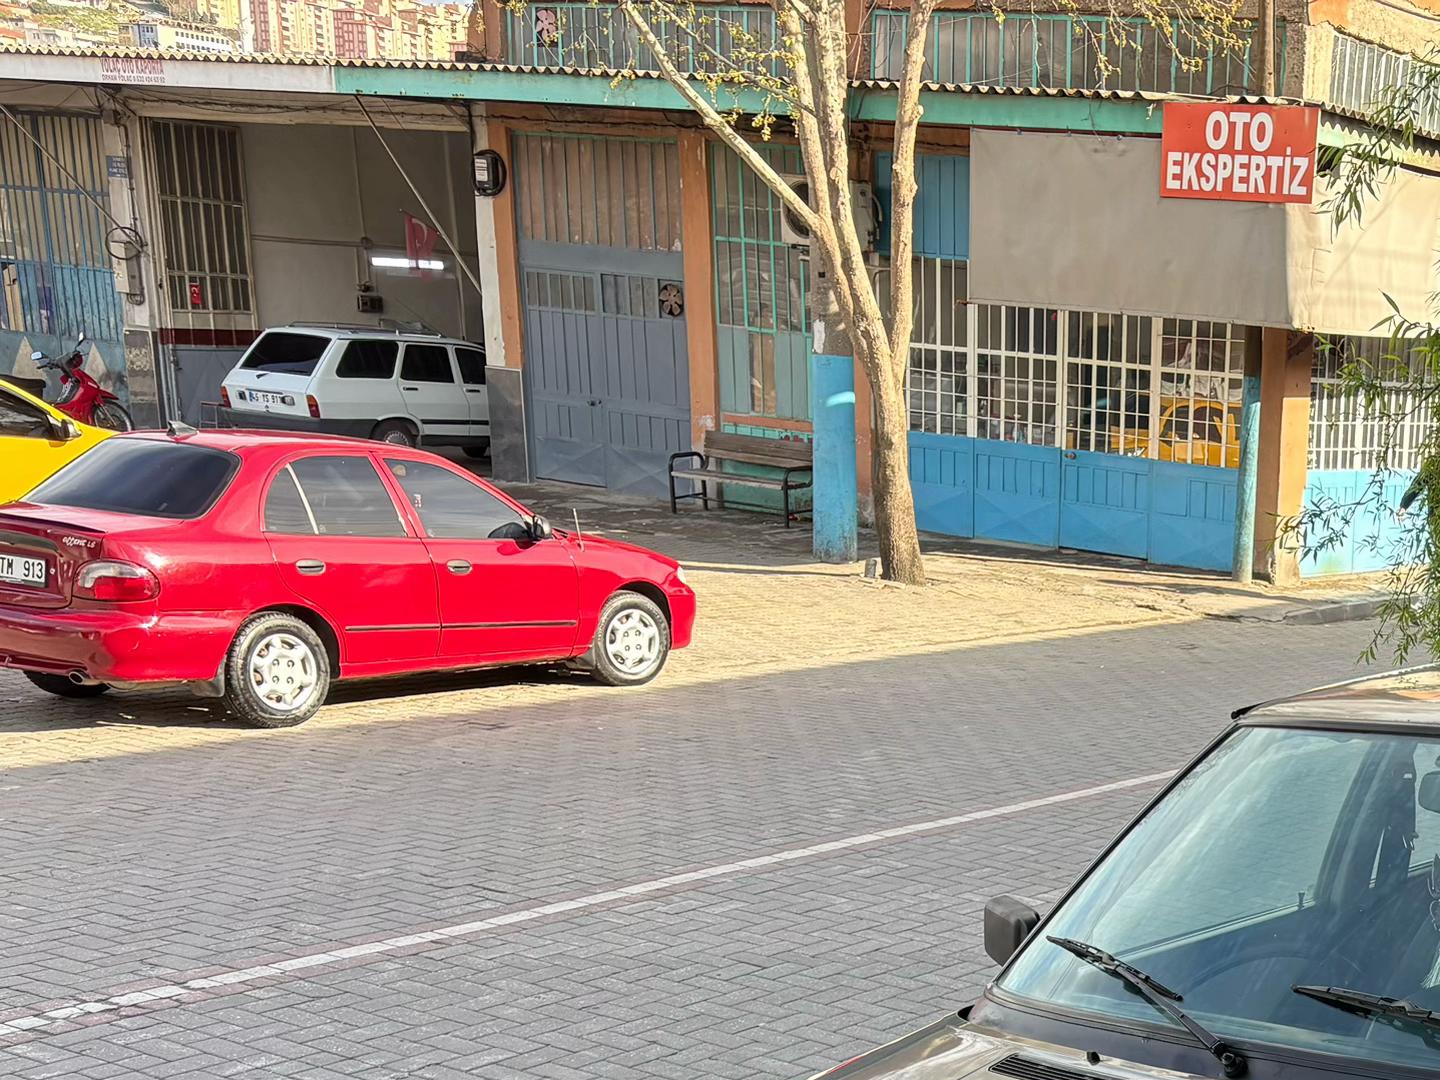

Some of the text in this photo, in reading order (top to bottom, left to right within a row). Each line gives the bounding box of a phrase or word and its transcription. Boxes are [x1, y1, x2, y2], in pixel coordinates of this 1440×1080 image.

[121, 58, 135, 74] OTO
[1205, 111, 1274, 152] OTO
[1166, 147, 1309, 195] EKSPERTİZ
[23, 560, 43, 579] 913
